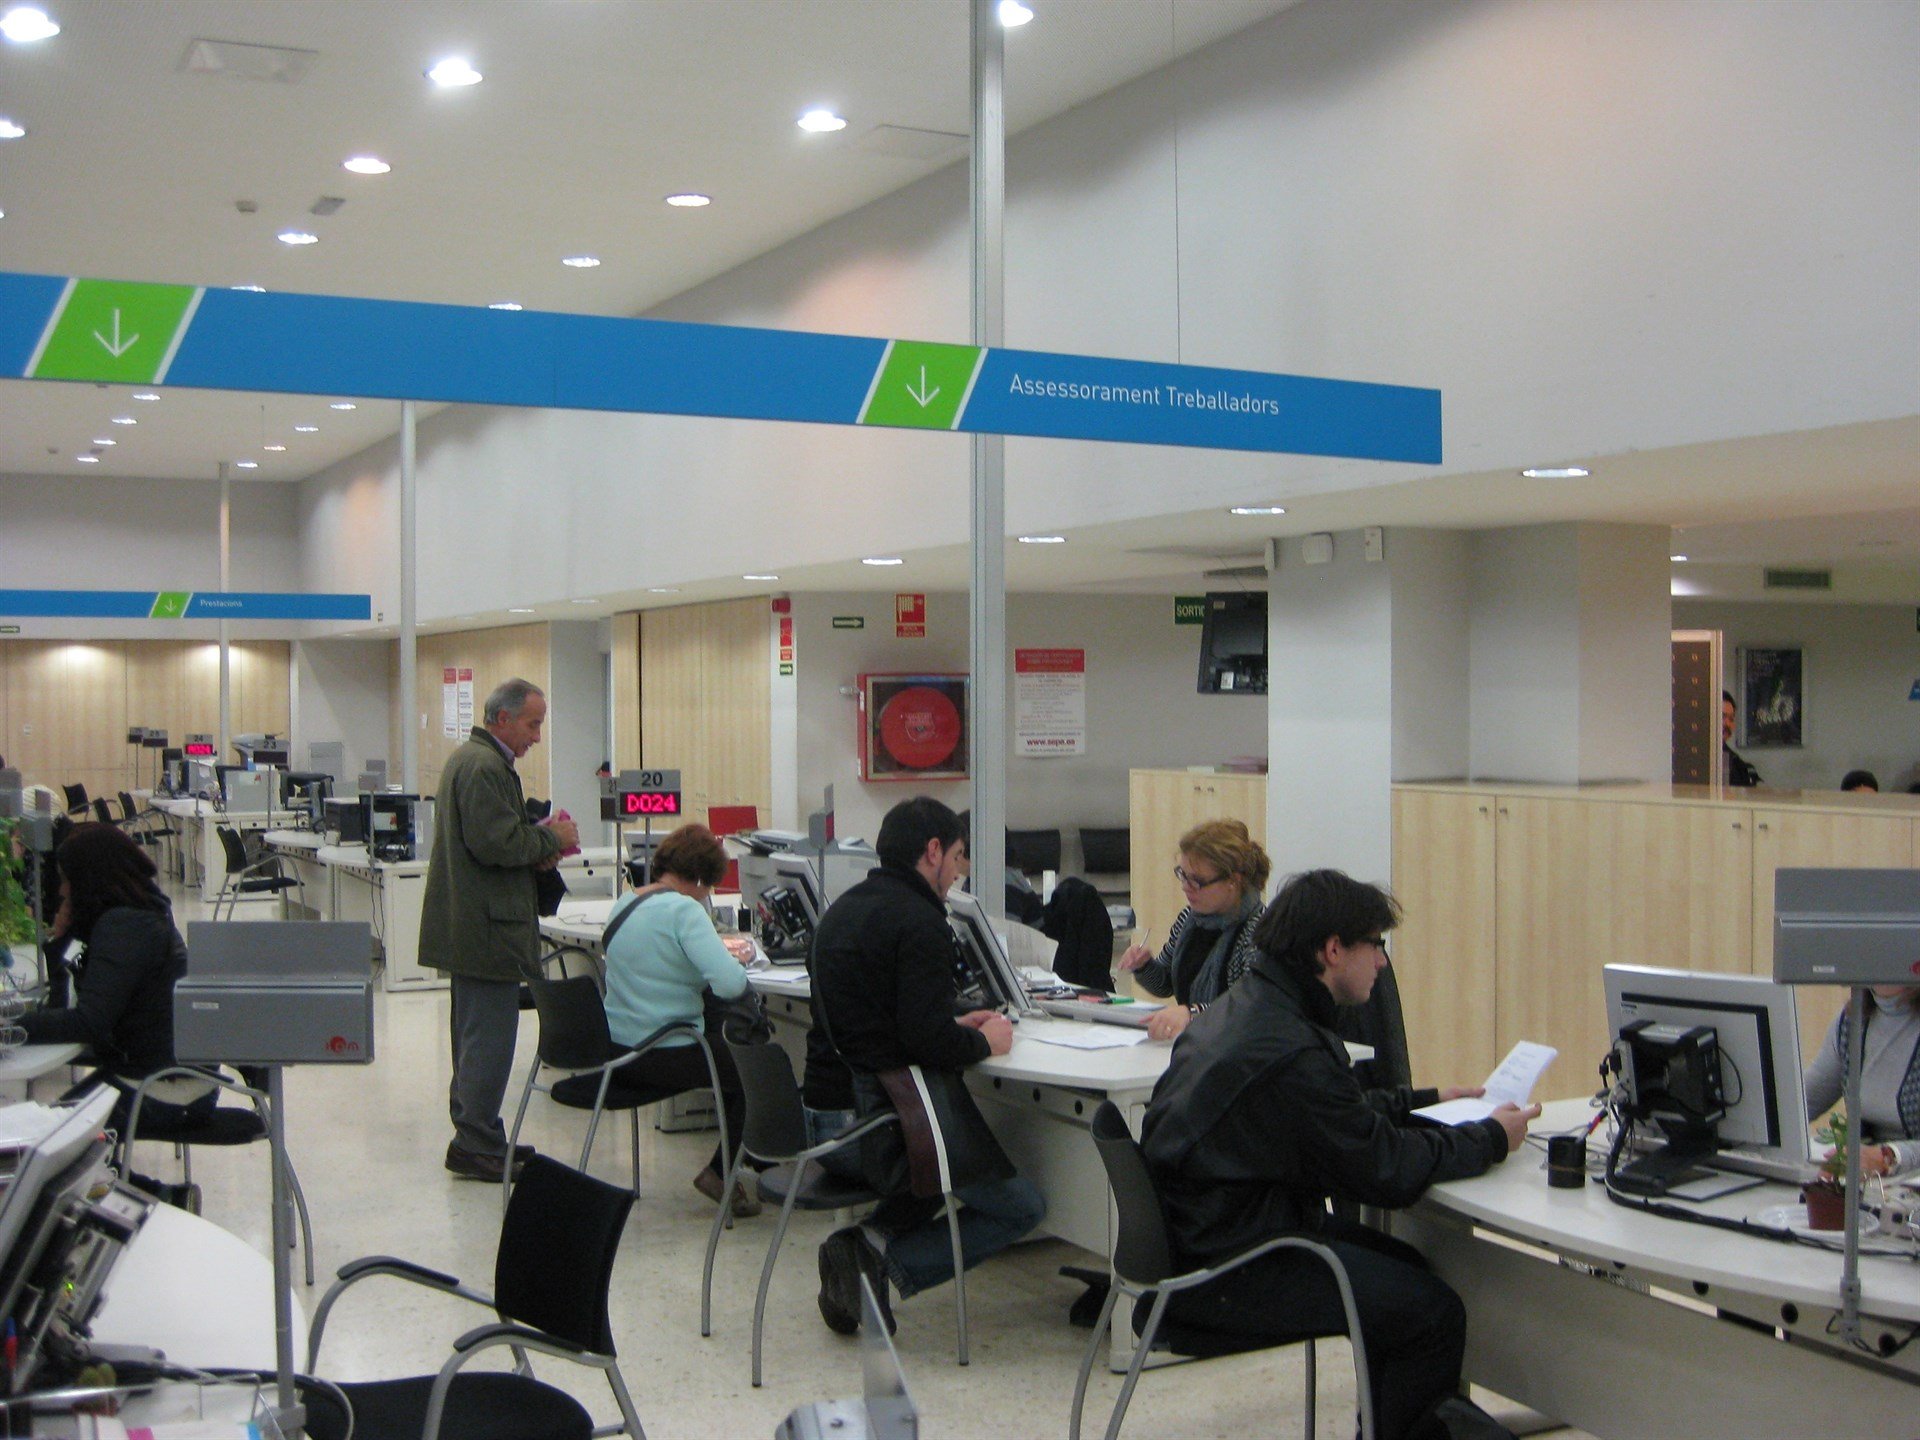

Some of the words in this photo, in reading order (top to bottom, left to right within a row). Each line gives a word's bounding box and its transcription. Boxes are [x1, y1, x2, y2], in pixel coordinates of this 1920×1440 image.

[1009, 373, 1161, 406] Assessorament
[1165, 385, 1280, 415] Treballadors
[200, 599, 243, 608] Prestacions
[641, 772, 663, 786] 20
[627, 793, 677, 813] D024
